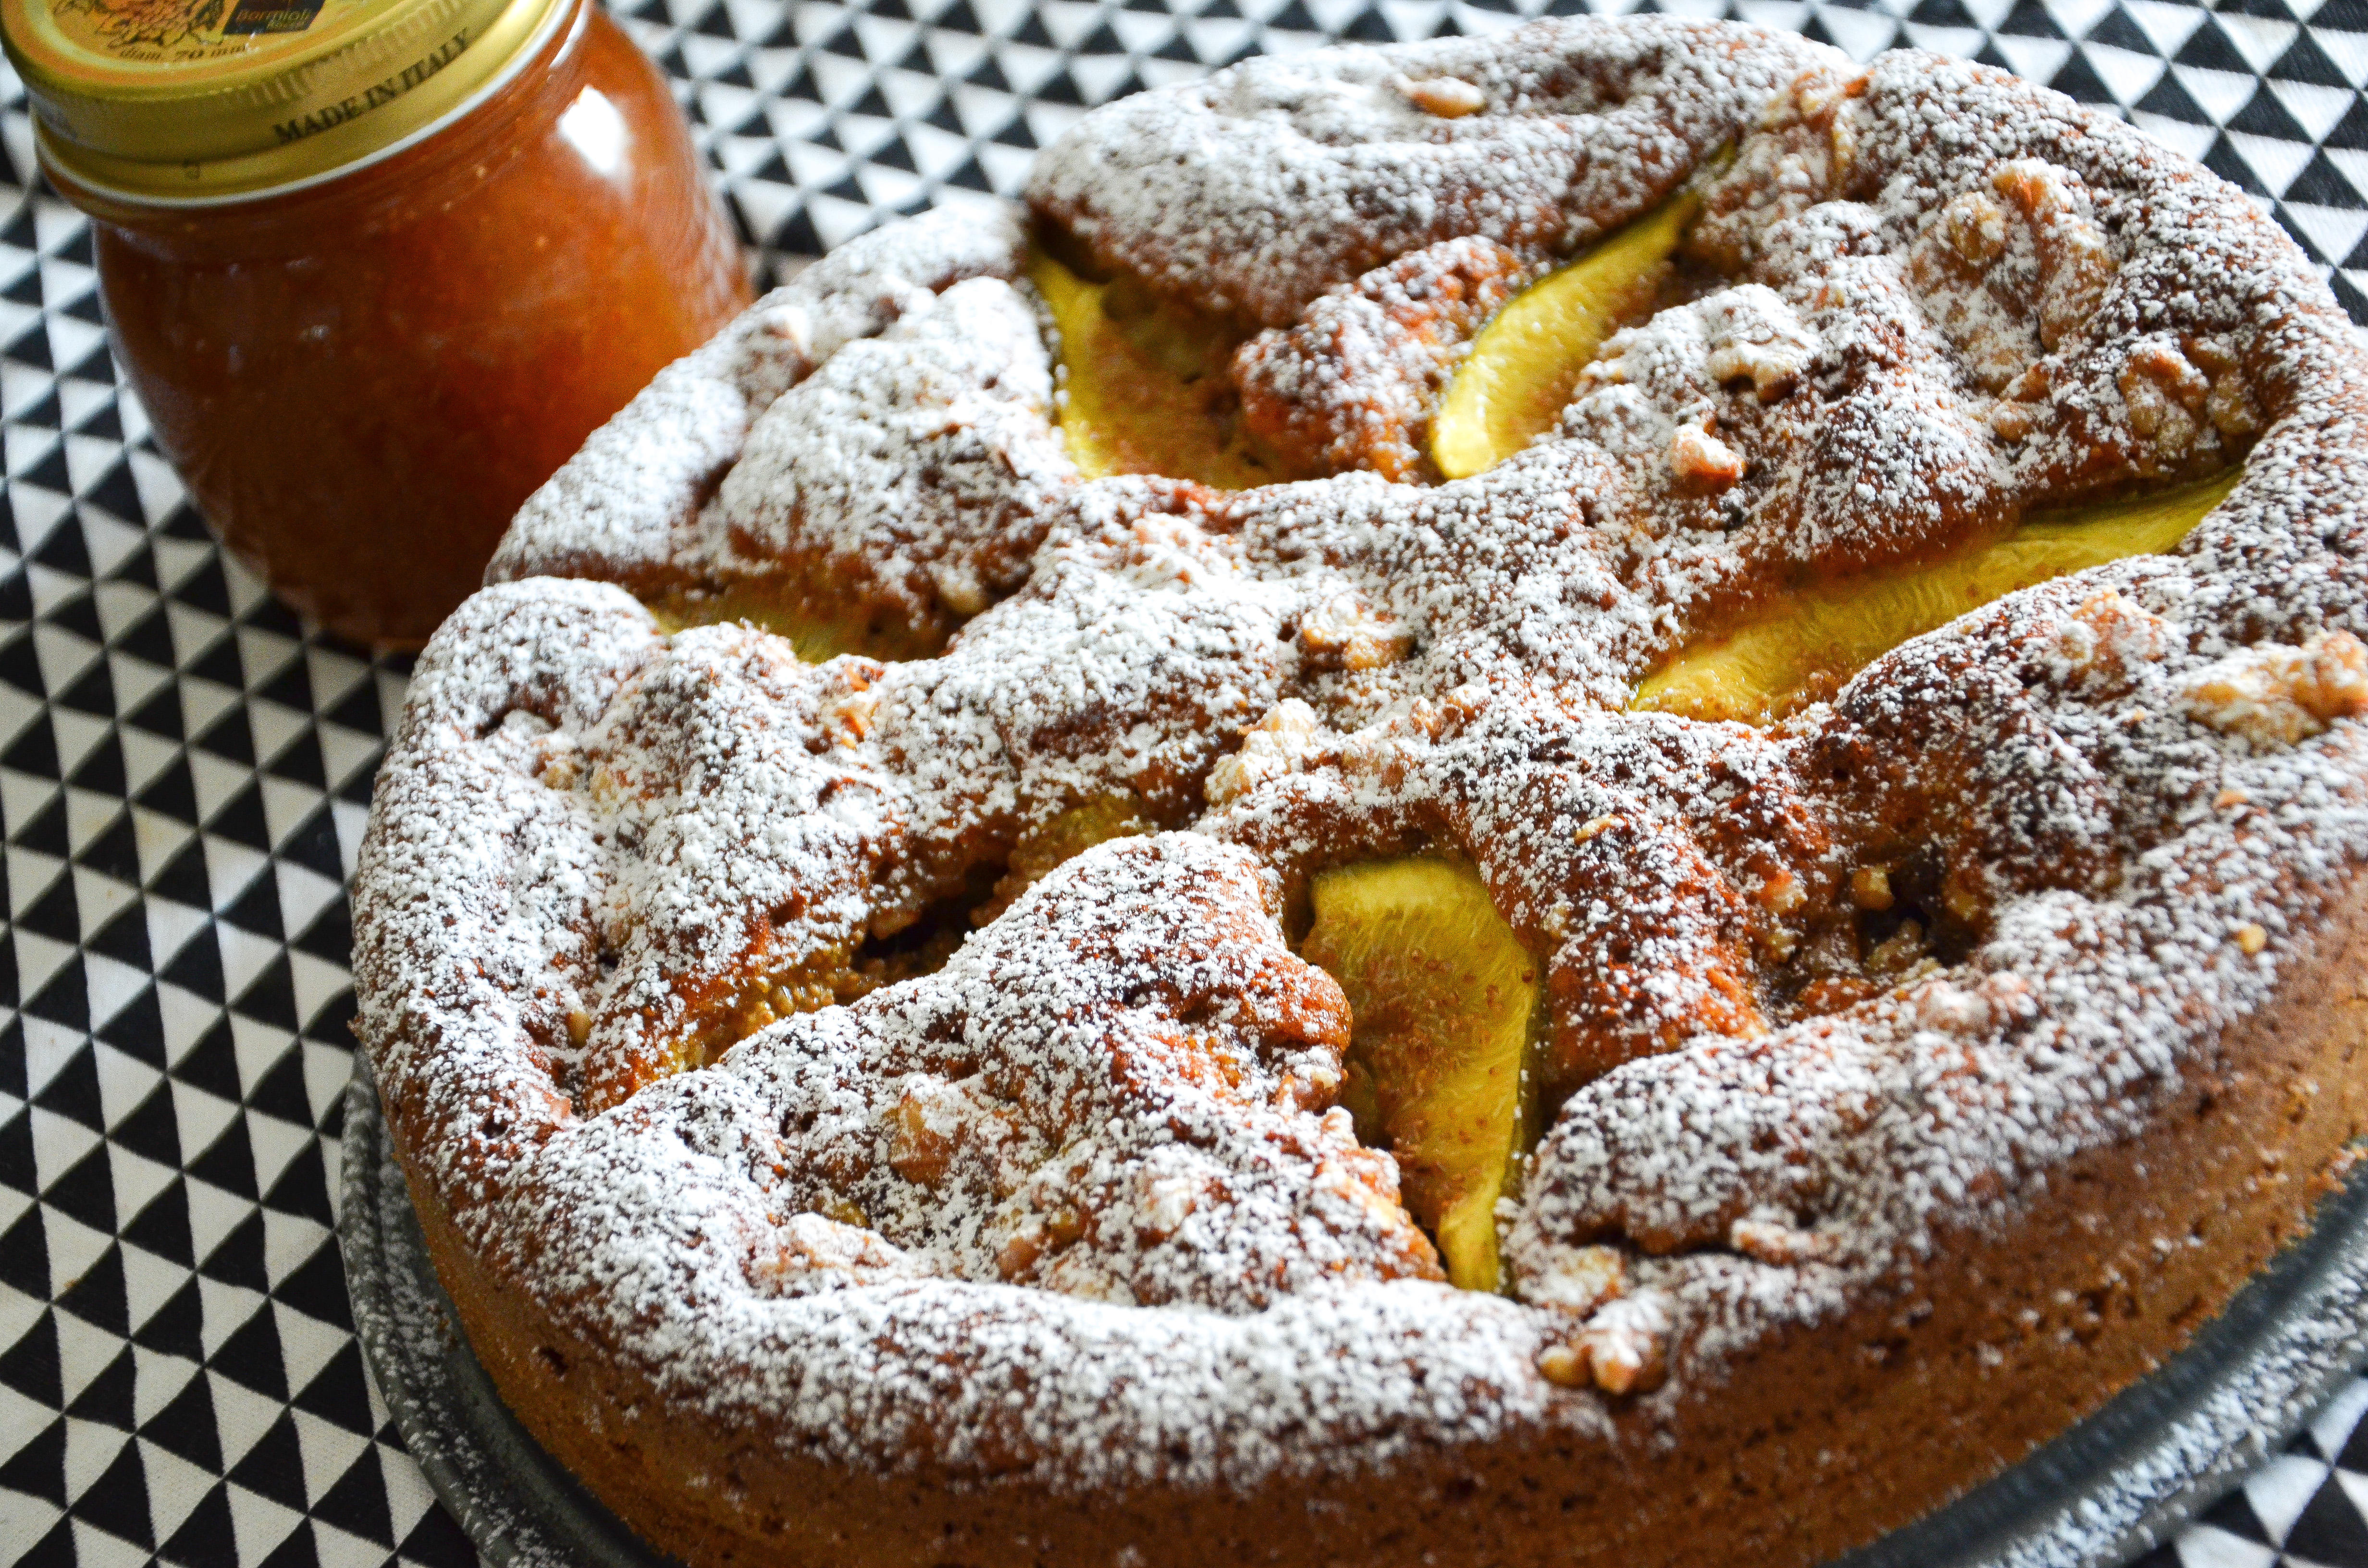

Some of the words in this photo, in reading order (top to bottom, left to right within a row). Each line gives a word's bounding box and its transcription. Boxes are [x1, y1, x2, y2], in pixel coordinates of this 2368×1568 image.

[173, 49, 204, 62] 70
[272, 96, 362, 143] MADE
[363, 77, 396, 109] IN
[398, 26, 469, 90] ITALY
